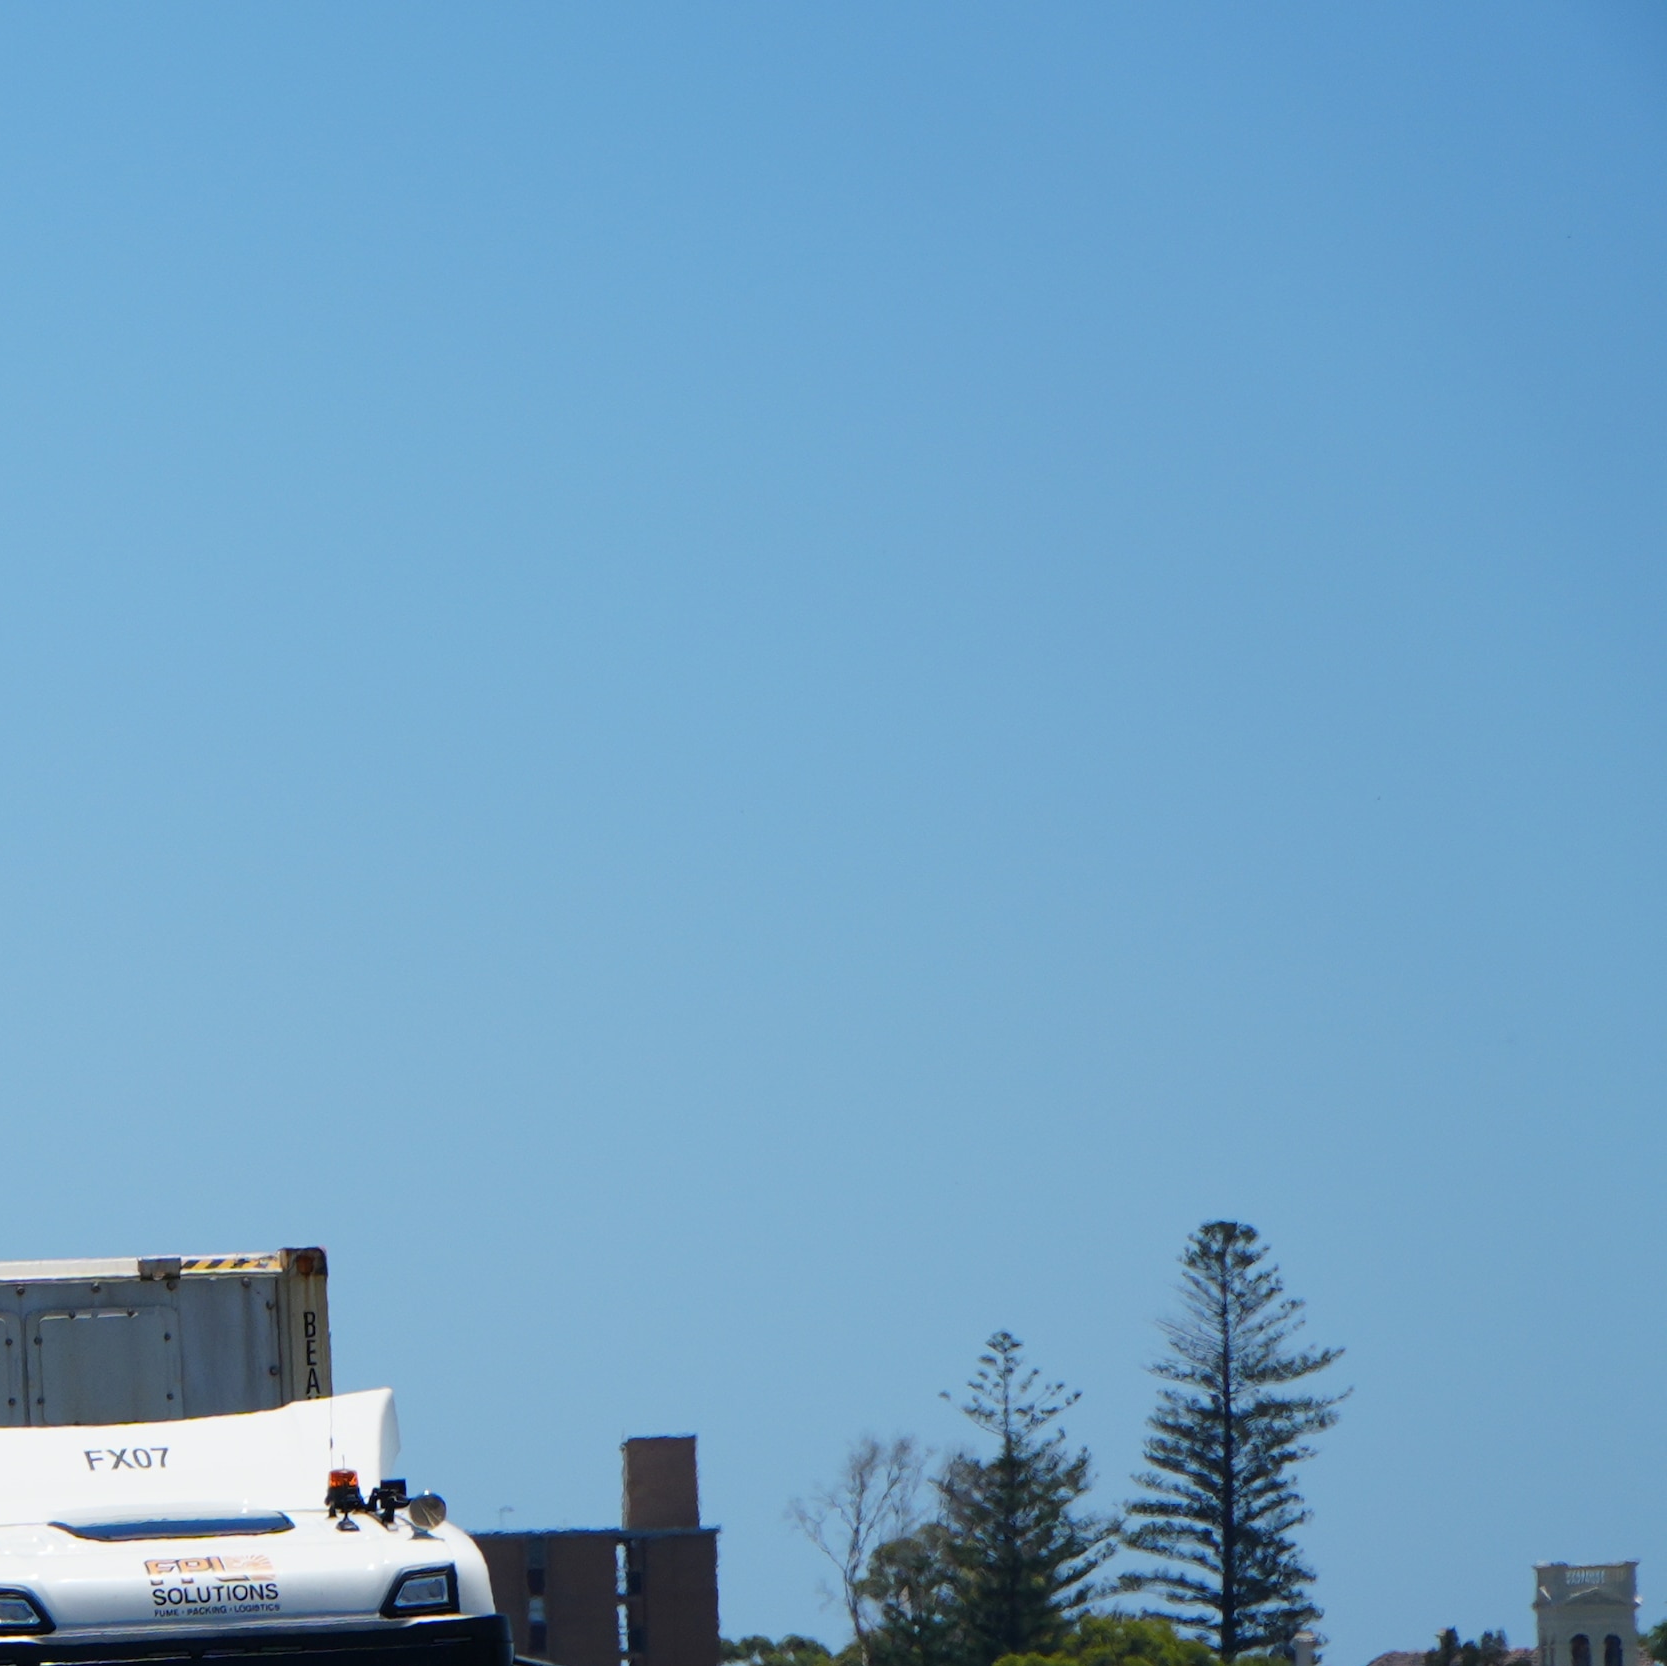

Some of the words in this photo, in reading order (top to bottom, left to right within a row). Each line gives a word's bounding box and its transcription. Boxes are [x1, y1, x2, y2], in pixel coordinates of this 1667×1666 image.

[304, 1311, 320, 1399] BEA
[84, 1447, 169, 1471] FX07
[144, 1556, 250, 1586] FPL
[152, 1583, 279, 1606] SOLUTIONS
[154, 1609, 180, 1617] FUME
[187, 1605, 227, 1616] PACKING
[234, 1603, 280, 1613] LOGISTICS
